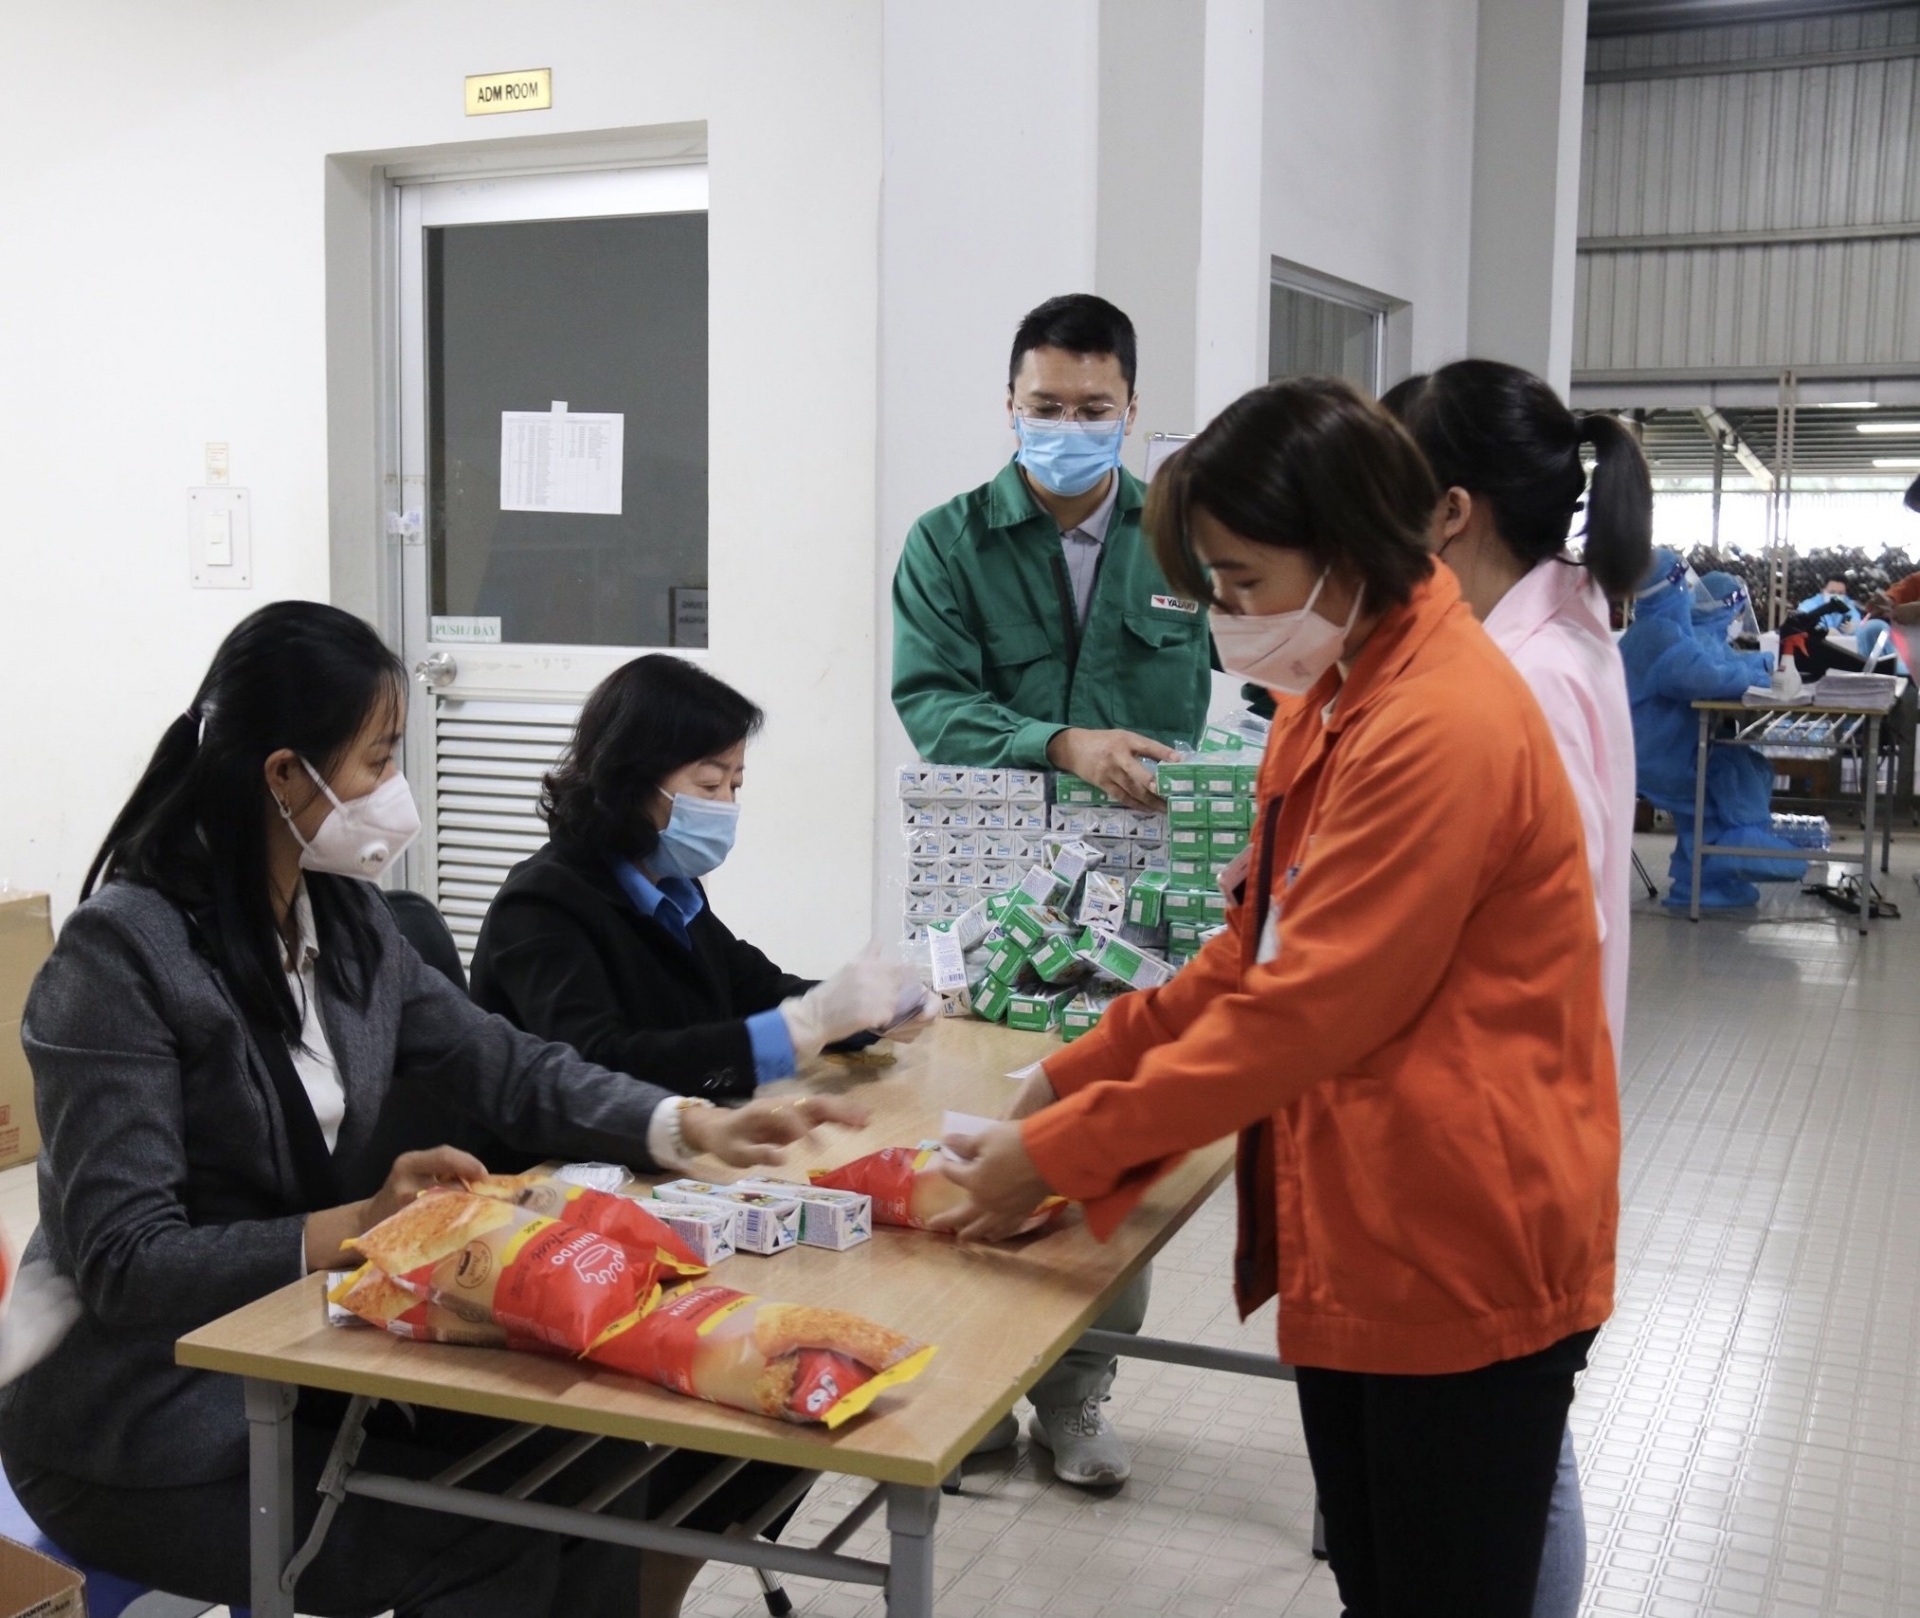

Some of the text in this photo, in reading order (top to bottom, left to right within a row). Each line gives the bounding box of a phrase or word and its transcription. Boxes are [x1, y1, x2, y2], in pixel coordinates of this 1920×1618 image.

[477, 82, 538, 103] ADM ROOM
[435, 625, 464, 635] PUSH
[570, 1231, 601, 1252] KINH
